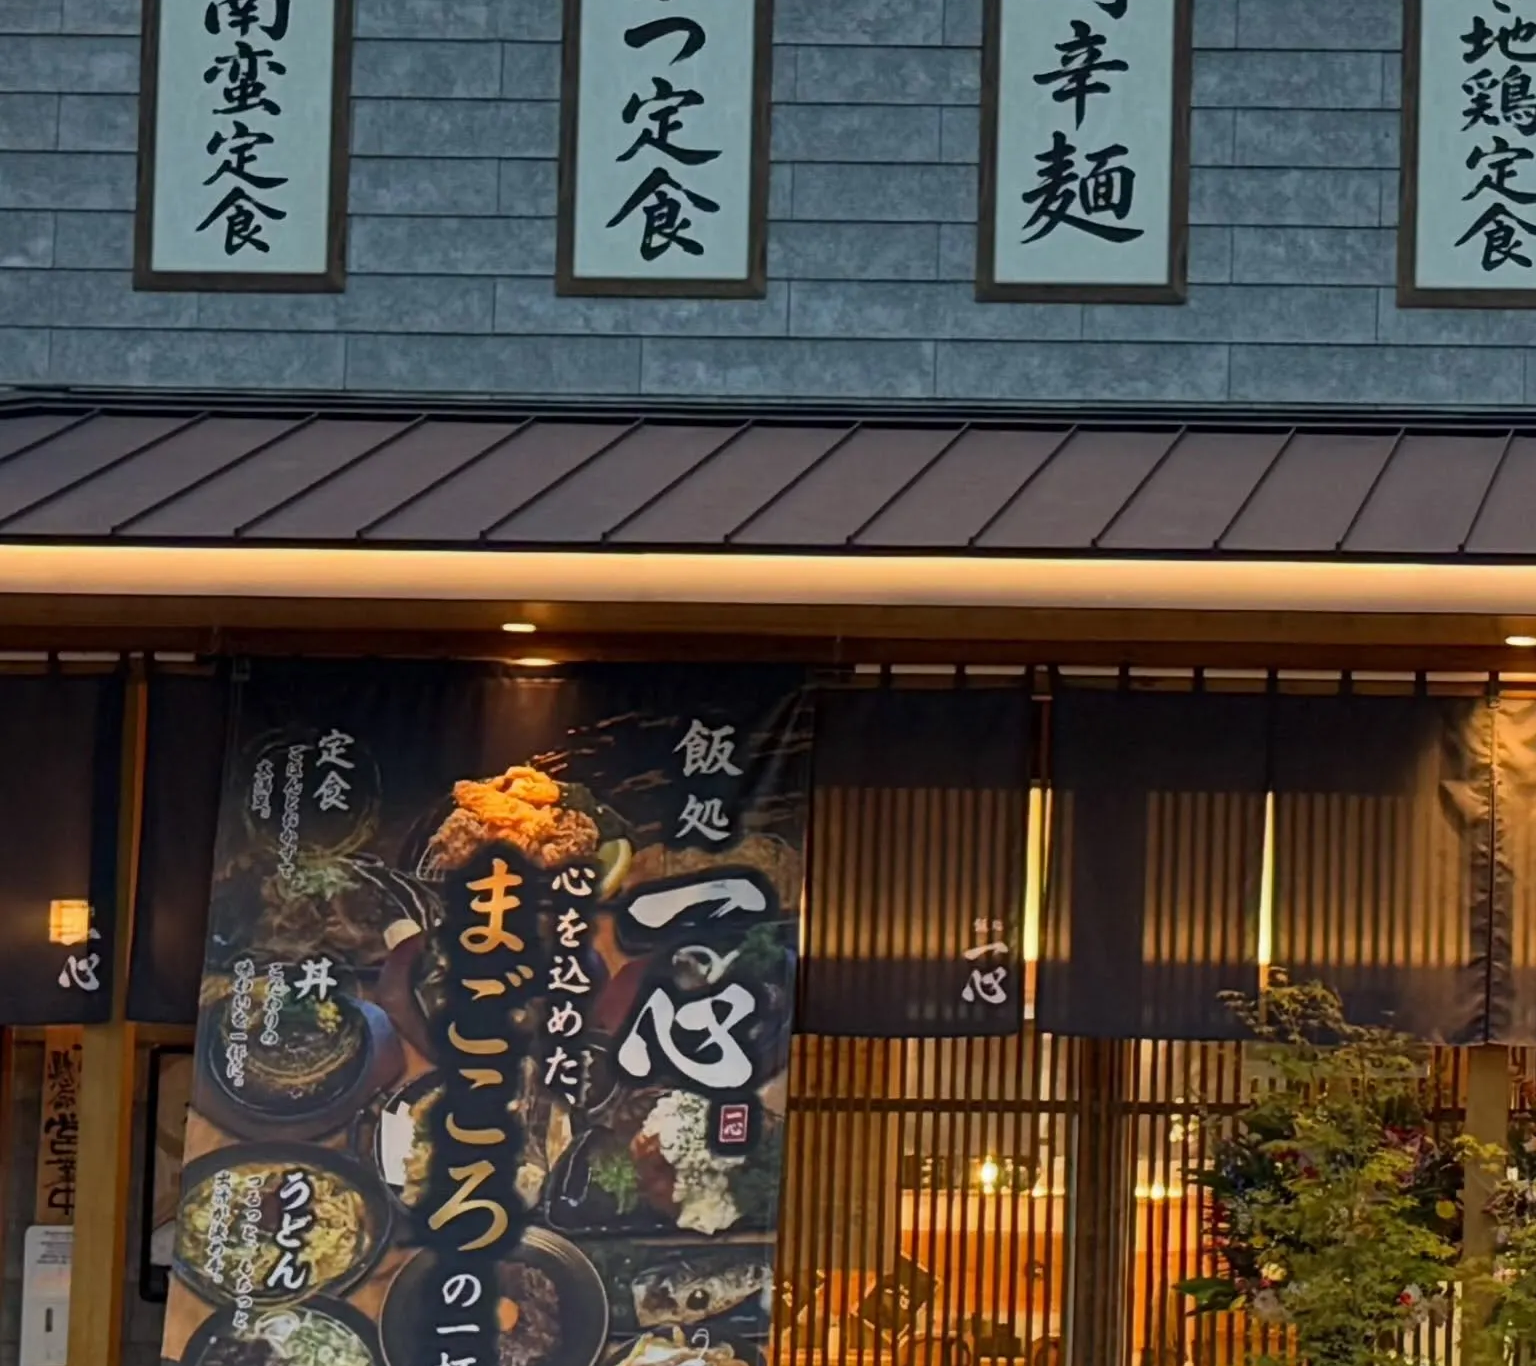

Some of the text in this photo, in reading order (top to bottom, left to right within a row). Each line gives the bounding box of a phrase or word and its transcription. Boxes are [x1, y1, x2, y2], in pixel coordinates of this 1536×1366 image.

[313, 728, 355, 811] 定食
[672, 719, 744, 841] 飯処
[294, 957, 337, 1000] 丼
[545, 866, 595, 1107] 心を込めた、
[618, 878, 766, 1089] 一心
[962, 941, 1009, 1004] 一心
[267, 1172, 312, 1289] うどん
